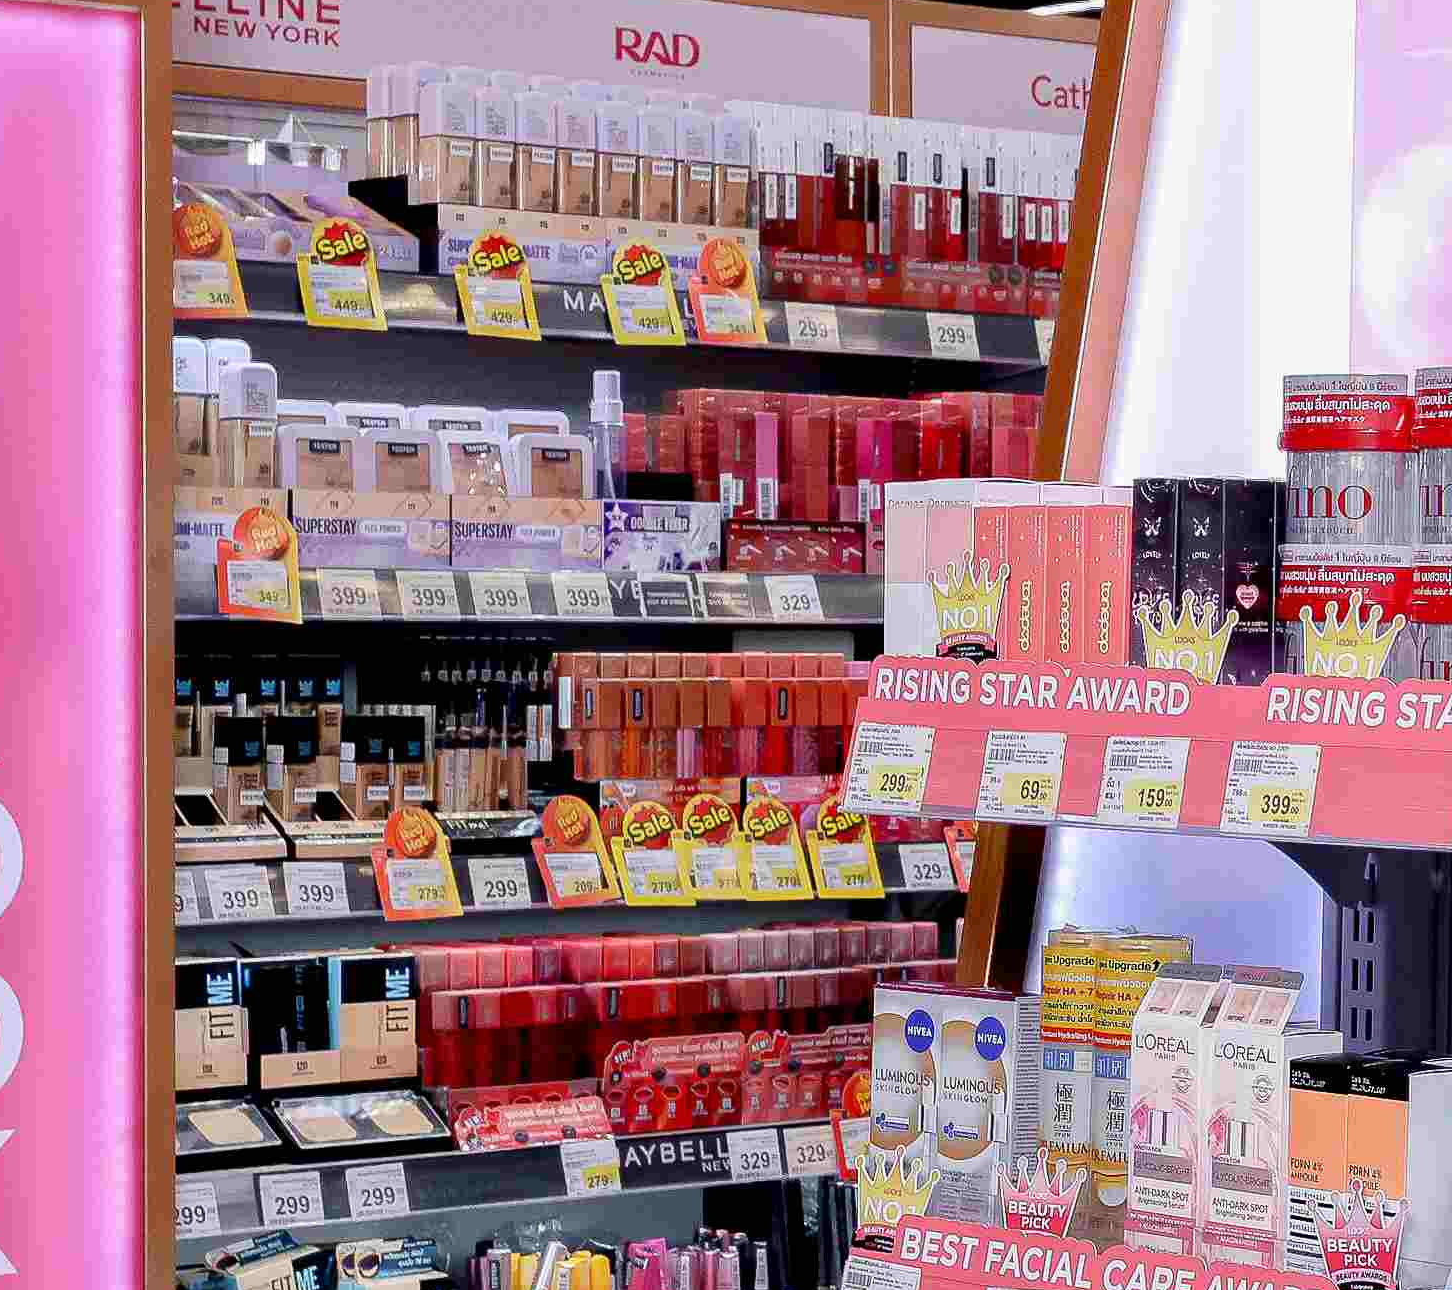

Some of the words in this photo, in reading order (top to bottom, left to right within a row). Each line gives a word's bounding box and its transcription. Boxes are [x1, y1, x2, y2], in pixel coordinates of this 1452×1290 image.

[193, 16, 256, 39] NEW
[264, 19, 340, 47] YORK
[614, 27, 701, 69] RAD
[317, 227, 367, 266] Sale
[294, 514, 358, 541] SUPERSTAY
[873, 667, 972, 706] RISING
[979, 673, 1063, 709] STAR
[1065, 675, 1193, 718] AWARD
[1266, 687, 1388, 729] RISING
[899, 1225, 979, 1270] BEST
